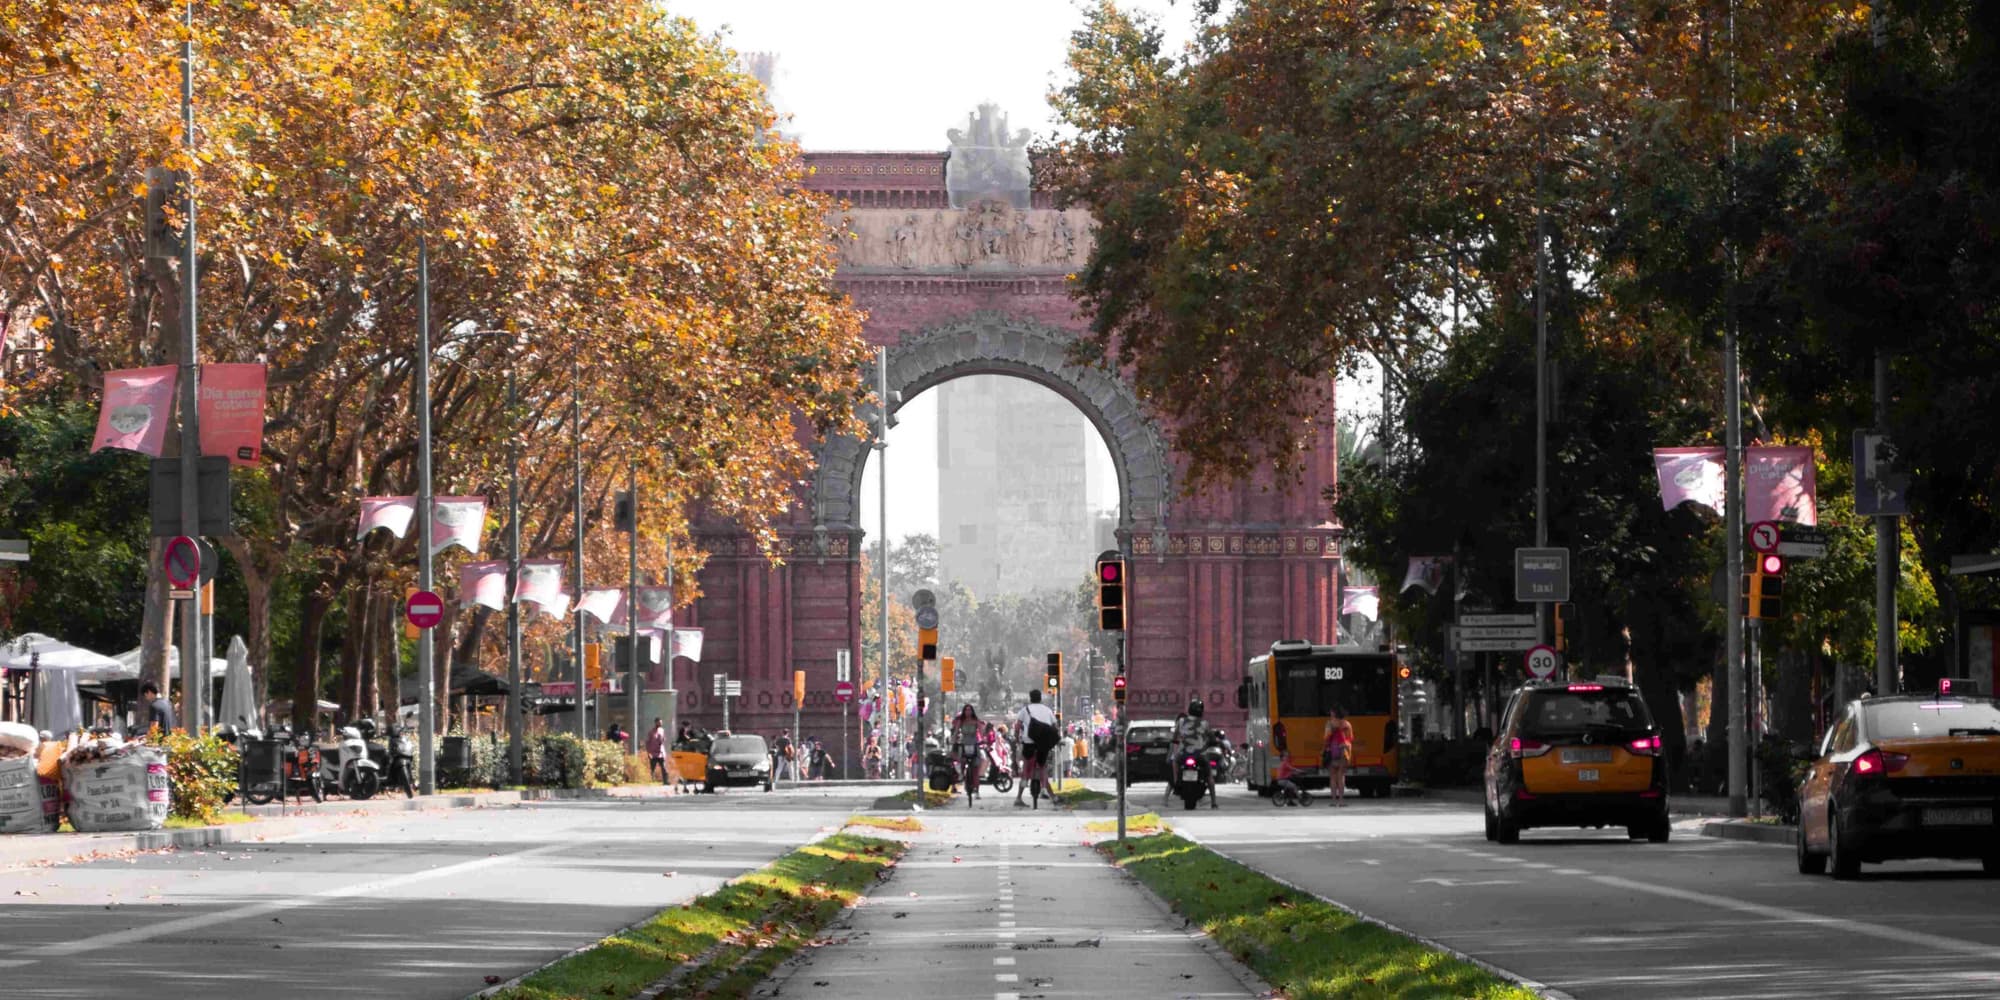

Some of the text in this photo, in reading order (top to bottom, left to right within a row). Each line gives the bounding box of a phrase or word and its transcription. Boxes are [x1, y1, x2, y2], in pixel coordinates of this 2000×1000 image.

[1532, 583, 1553, 593] taxi
[1533, 657, 1552, 668] 30
[1325, 667, 1343, 680] B20
[1943, 680, 1950, 691] P
